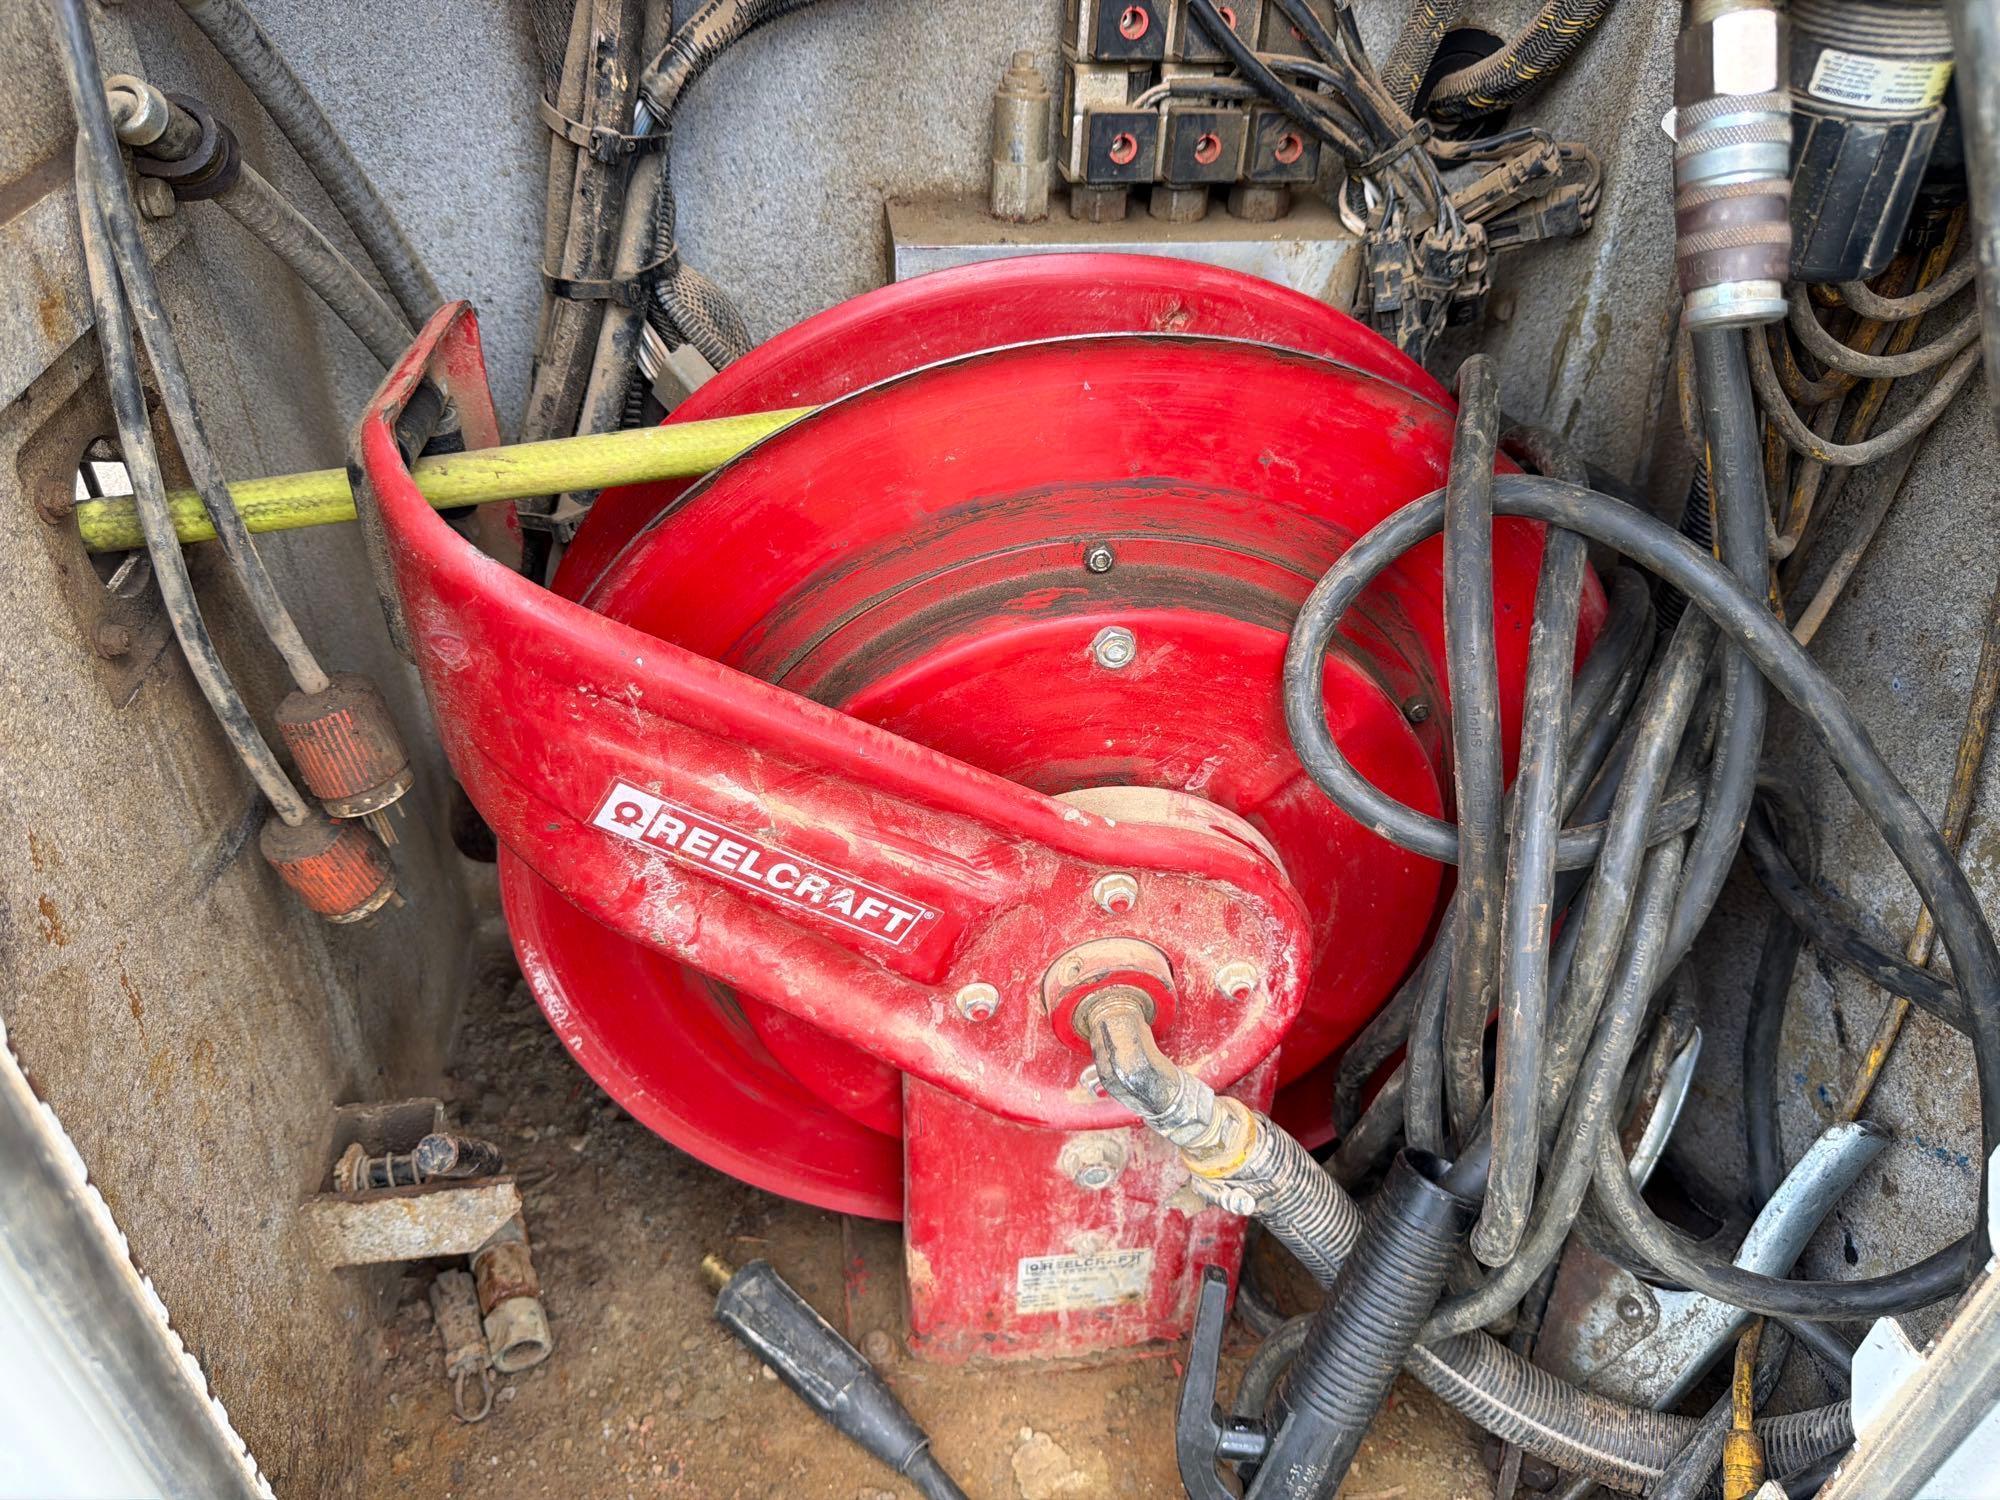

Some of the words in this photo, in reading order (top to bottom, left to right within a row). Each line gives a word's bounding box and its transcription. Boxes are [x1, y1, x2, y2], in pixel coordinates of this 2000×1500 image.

[1469, 706, 1482, 749] RoHS
[647, 812, 914, 933] REELCRAFT
[1576, 1122, 1590, 1141] 1/0
[1621, 938, 1648, 1006] WELDING
[1641, 887, 1663, 932] CABLE
